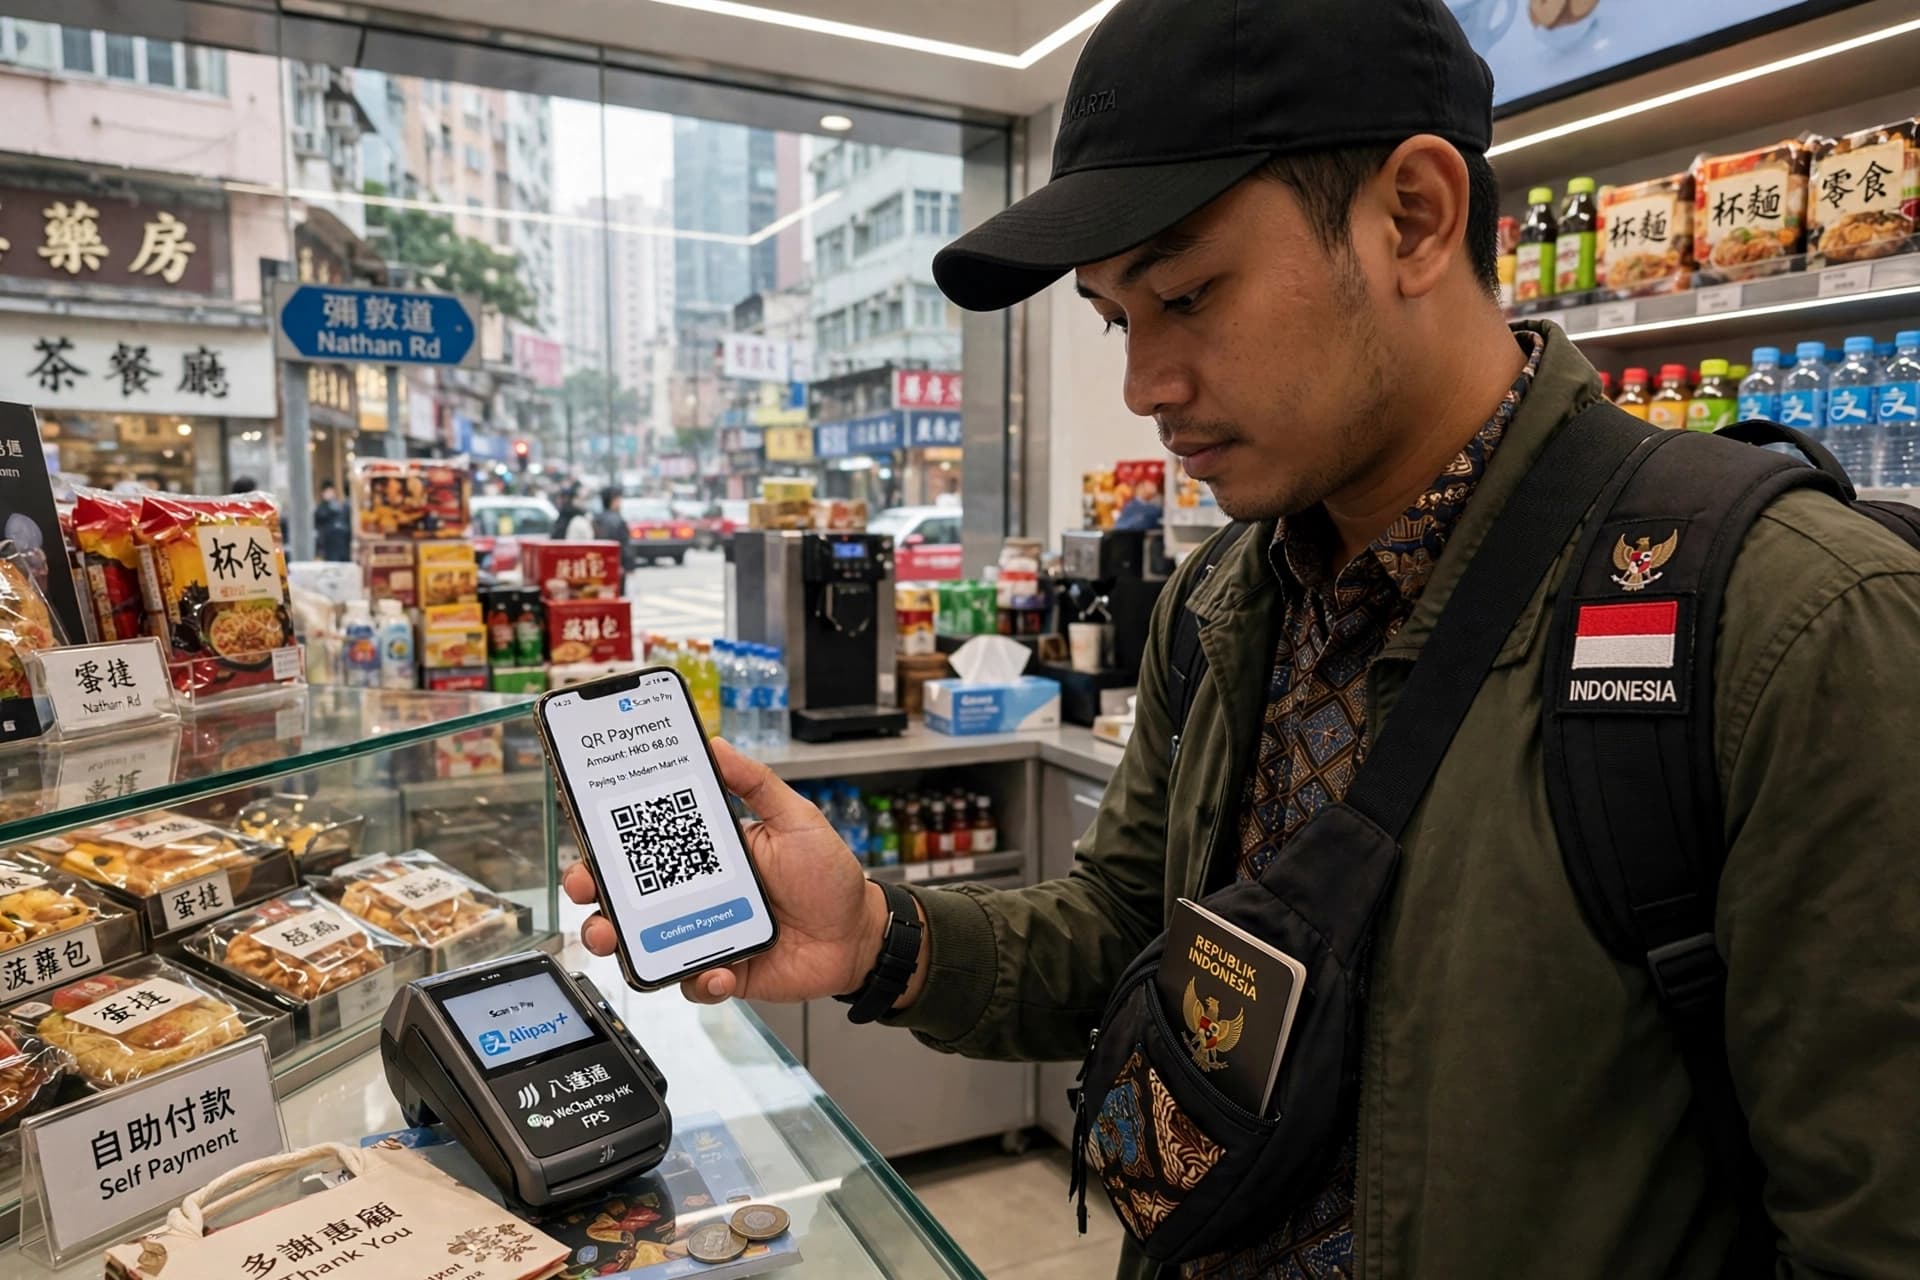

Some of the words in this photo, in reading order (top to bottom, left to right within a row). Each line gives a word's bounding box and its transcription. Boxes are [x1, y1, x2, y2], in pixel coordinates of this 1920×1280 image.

[1822, 160, 1893, 208] 零食
[0, 200, 197, 284] 藥房
[321, 293, 435, 334] 彌敦道
[317, 330, 402, 356] Nathan
[409, 336, 442, 359] Rd
[27, 336, 229, 398] 茶餐廳
[209, 536, 273, 581] 杯食
[1569, 680, 1677, 702] INDONESIA
[581, 732, 606, 749] QR
[607, 716, 672, 742] Payment
[628, 743, 650, 757] HKD
[651, 735, 680, 750] 68.00
[660, 922, 696, 940] Confirm
[695, 908, 735, 929] Payment
[1188, 946, 1257, 1001] INDONESIA
[1195, 934, 1257, 983] REPUBLIK
[553, 1098, 597, 1118] WeChat
[595, 1092, 616, 1105] Pay
[615, 1084, 634, 1098] HK
[581, 1110, 610, 1128] FPS
[91, 1086, 235, 1170] 自助付款
[100, 1164, 142, 1200] Self
[147, 1127, 239, 1180] Payment
[240, 1201, 403, 1280] 多謝惠顧
[361, 1226, 413, 1250] You
